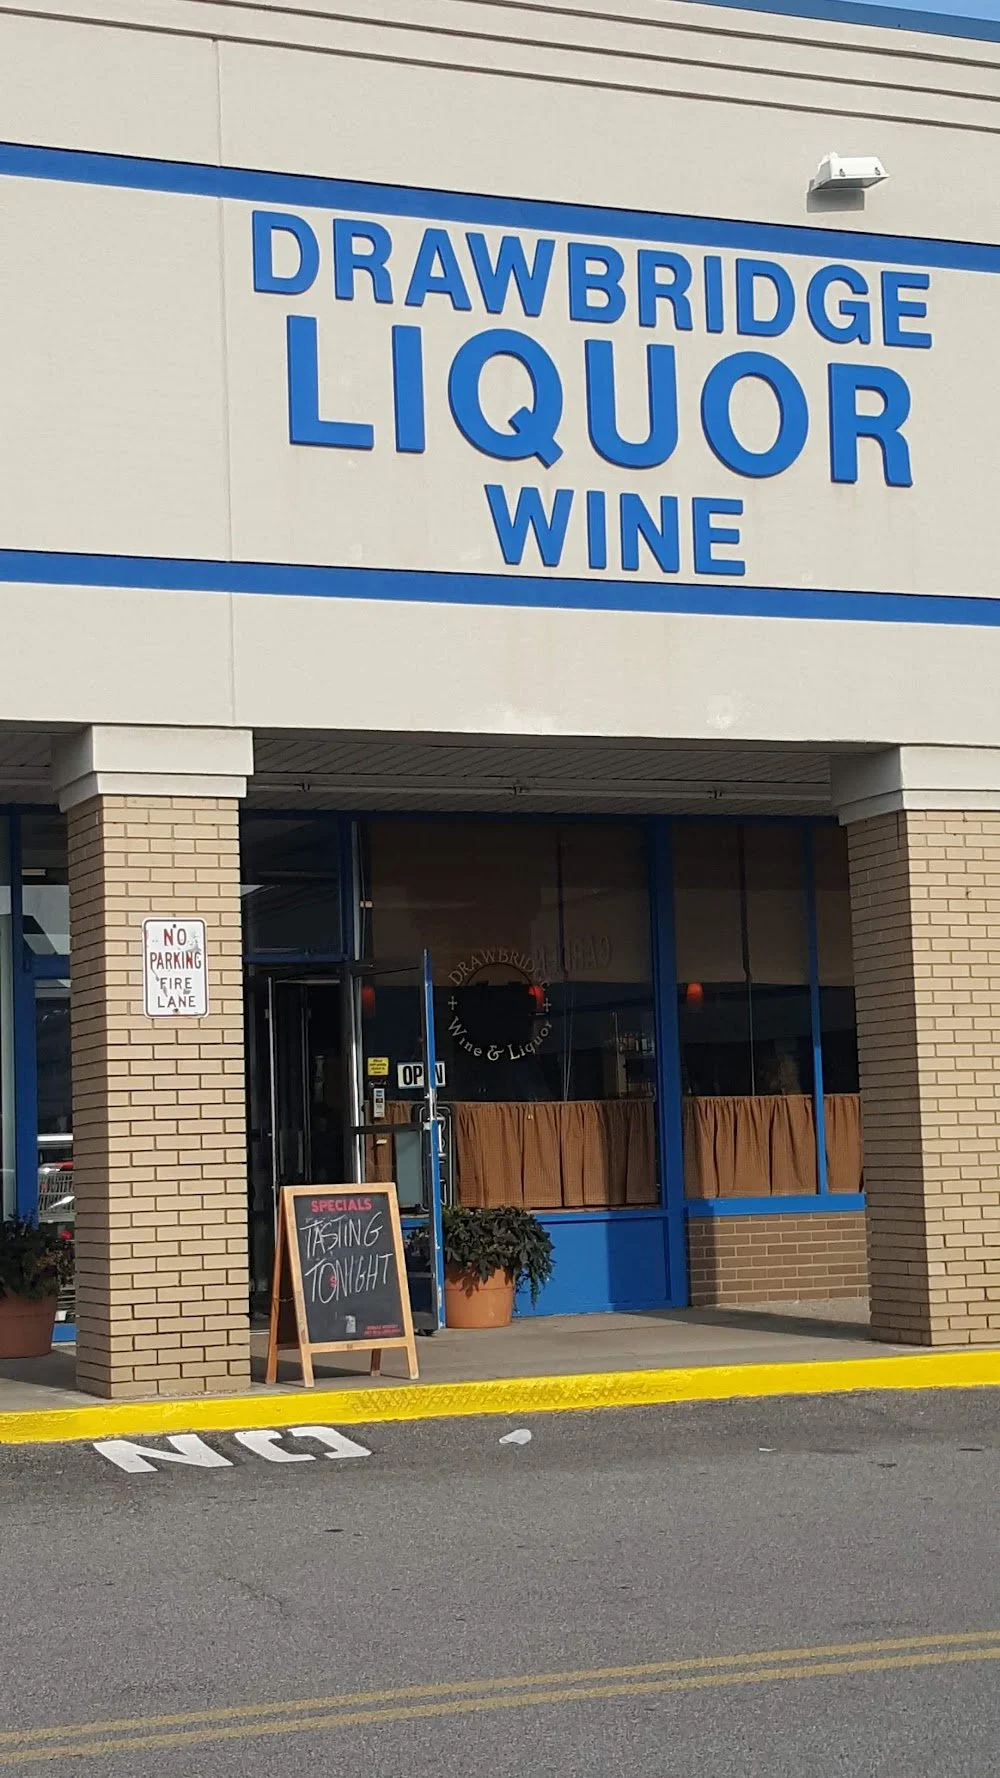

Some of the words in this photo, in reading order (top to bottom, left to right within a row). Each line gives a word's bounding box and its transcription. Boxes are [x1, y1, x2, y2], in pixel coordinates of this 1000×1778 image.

[252, 210, 932, 349] DRAWBRIDGE
[286, 315, 912, 487] LIQUOR
[484, 484, 746, 577] WINE
[163, 928, 187, 946] NO
[150, 951, 202, 970] PARKING
[448, 947, 552, 992] DRAWBRIDGE
[157, 995, 197, 1008] LANE
[160, 977, 192, 990] FIRE
[448, 1015, 483, 1057] Wine
[486, 1045, 505, 1061] &
[508, 1020, 553, 1061] Liquor
[402, 1064, 443, 1086] OPN
[311, 1199, 373, 1213] SPECIALS
[300, 1211, 384, 1259] TASTING
[305, 1253, 393, 1304] TONIGHT
[93, 1426, 373, 1474] NO
